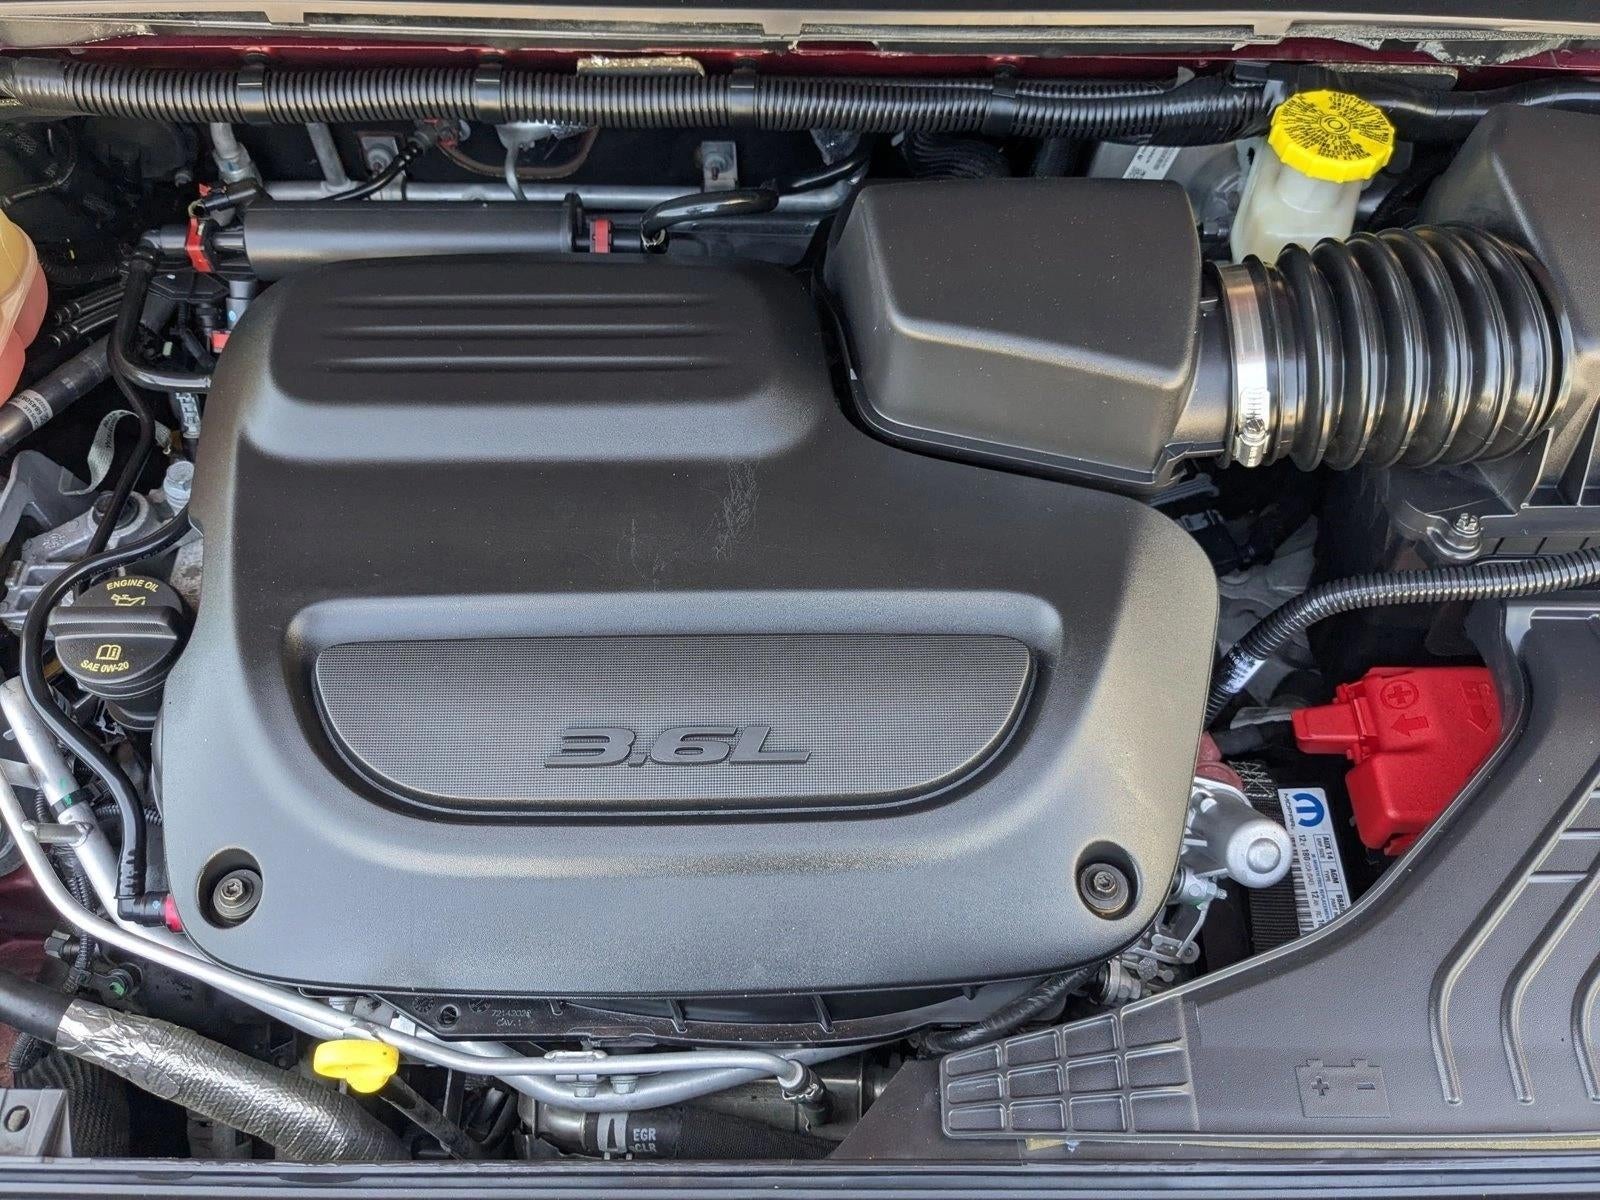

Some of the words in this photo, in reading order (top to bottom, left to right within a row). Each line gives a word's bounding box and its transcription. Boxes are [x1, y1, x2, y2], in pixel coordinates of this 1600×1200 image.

[106, 579, 145, 591] ENGINE
[144, 580, 159, 593] OIL
[81, 660, 100, 672] SAE
[100, 661, 130, 674] 0W-20
[544, 725, 812, 768] 3.6L
[1323, 837, 1331, 849] AUX
[1302, 849, 1310, 860] 180
[1326, 851, 1333, 860] 14
[1330, 868, 1338, 884] AGM
[633, 1127, 657, 1141] EGR
